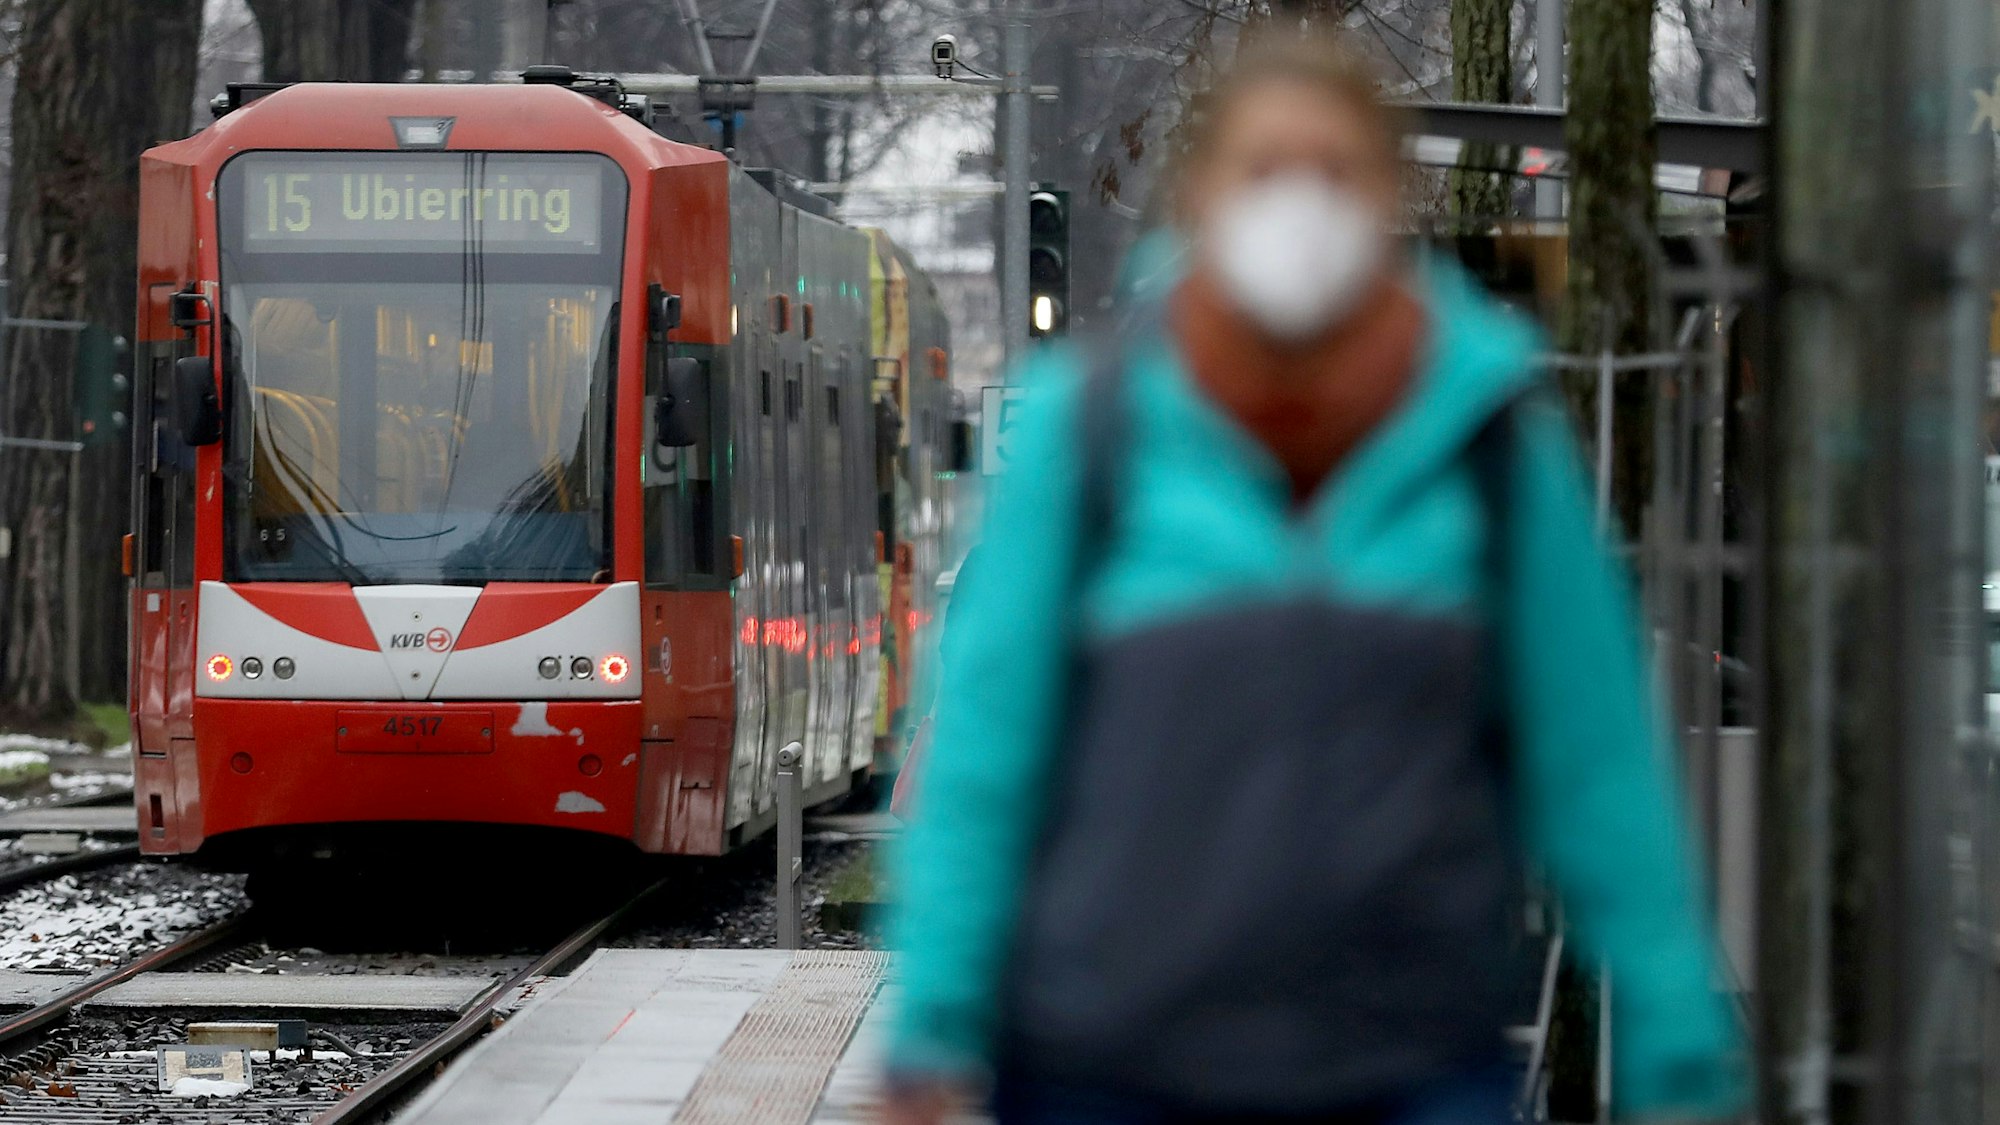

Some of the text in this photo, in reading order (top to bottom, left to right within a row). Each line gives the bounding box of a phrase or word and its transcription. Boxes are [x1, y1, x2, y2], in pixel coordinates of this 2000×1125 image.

[264, 173, 570, 234] 15 Ubierring
[391, 633, 425, 648] KVB
[383, 716, 443, 737] 4517
